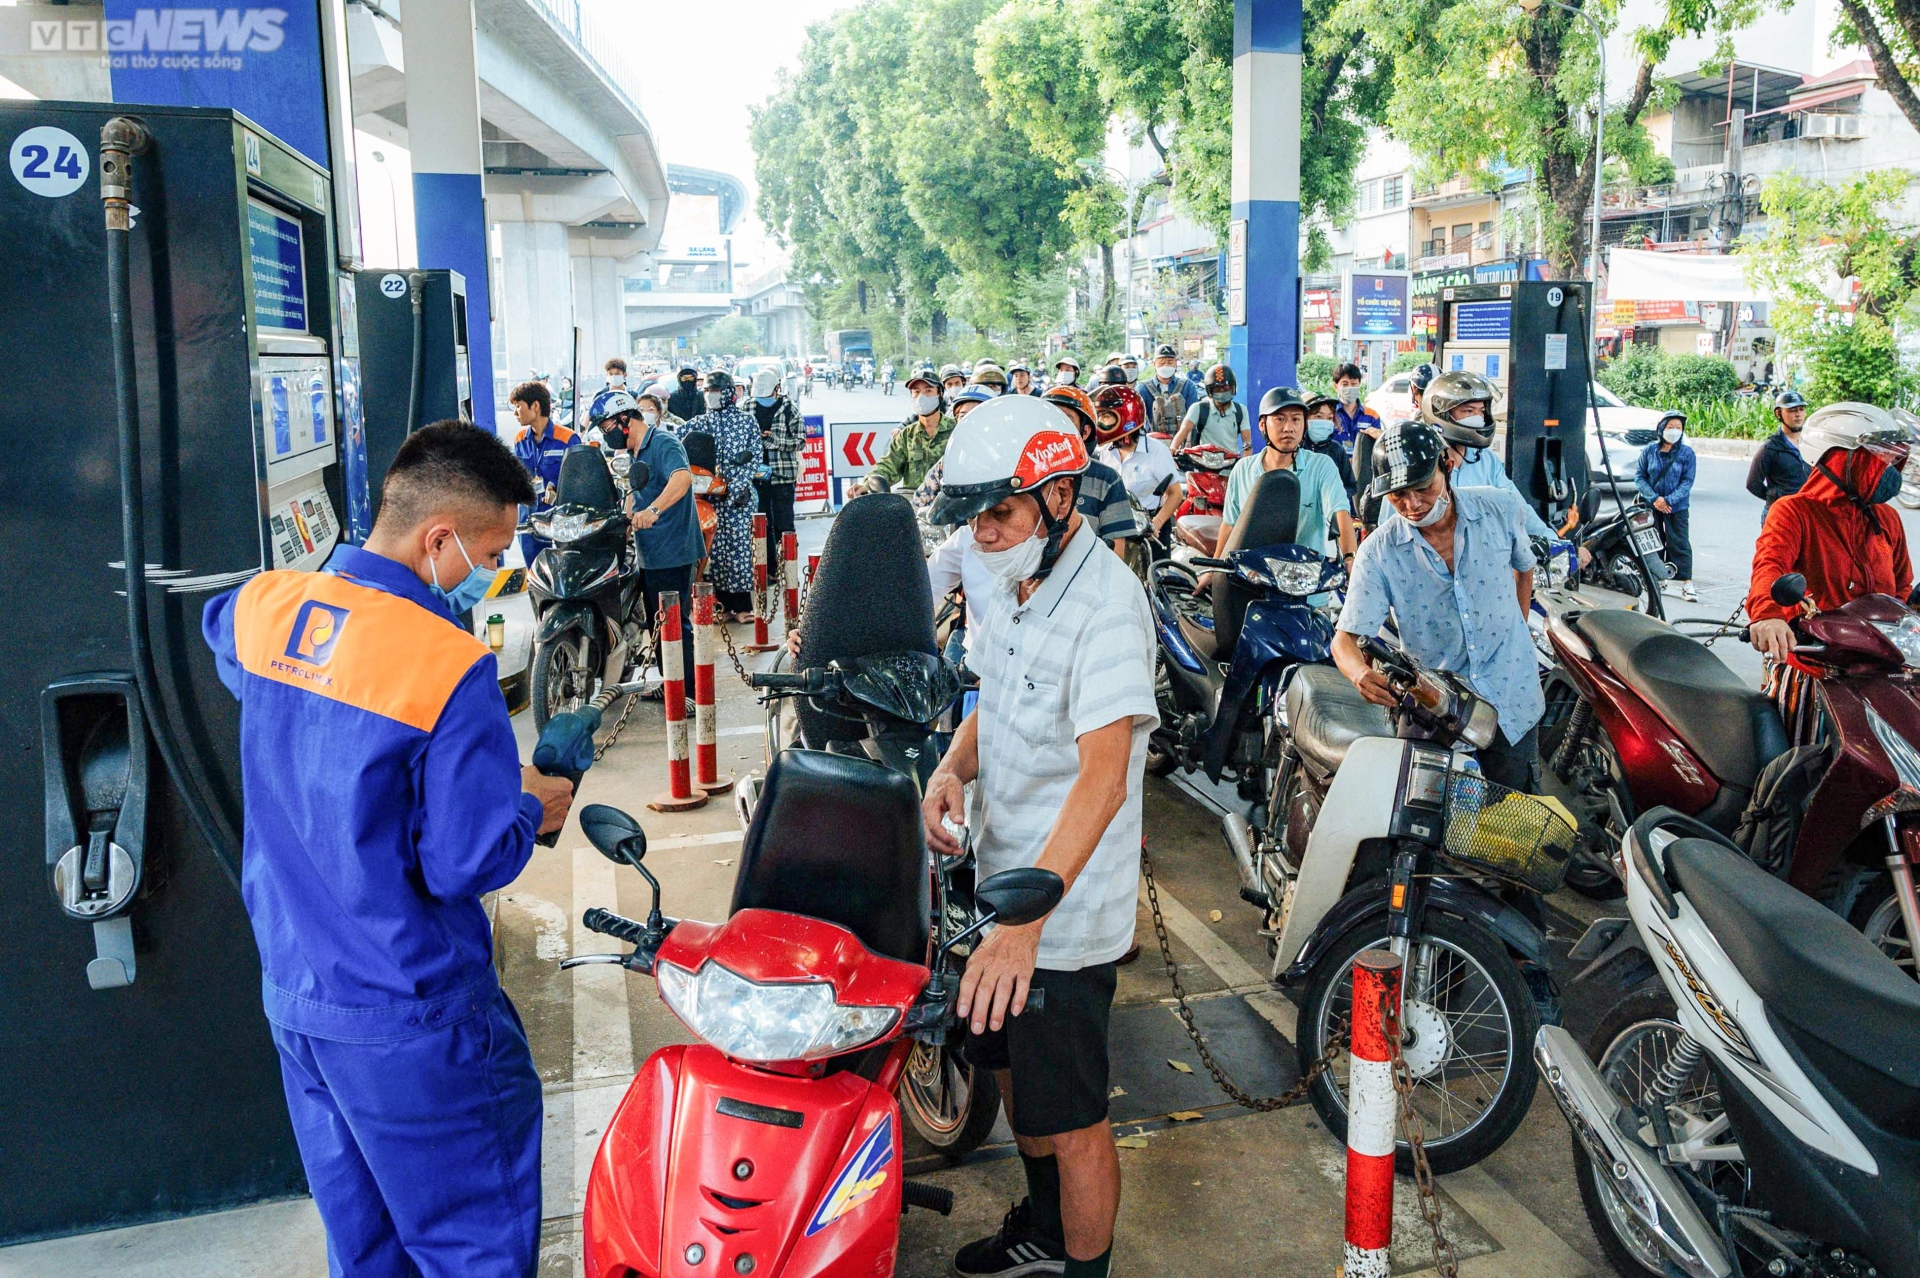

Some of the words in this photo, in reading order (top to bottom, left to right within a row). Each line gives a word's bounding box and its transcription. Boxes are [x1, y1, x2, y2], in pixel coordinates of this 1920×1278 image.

[246, 136, 259, 171] 24
[20, 144, 82, 180] 24
[384, 280, 404, 292] 22
[1502, 286, 1510, 296] 19
[1445, 290, 1453, 299] 20
[1550, 292, 1561, 301] 19
[1026, 437, 1073, 468] VinMart
[796, 473, 825, 484] OLIMEX
